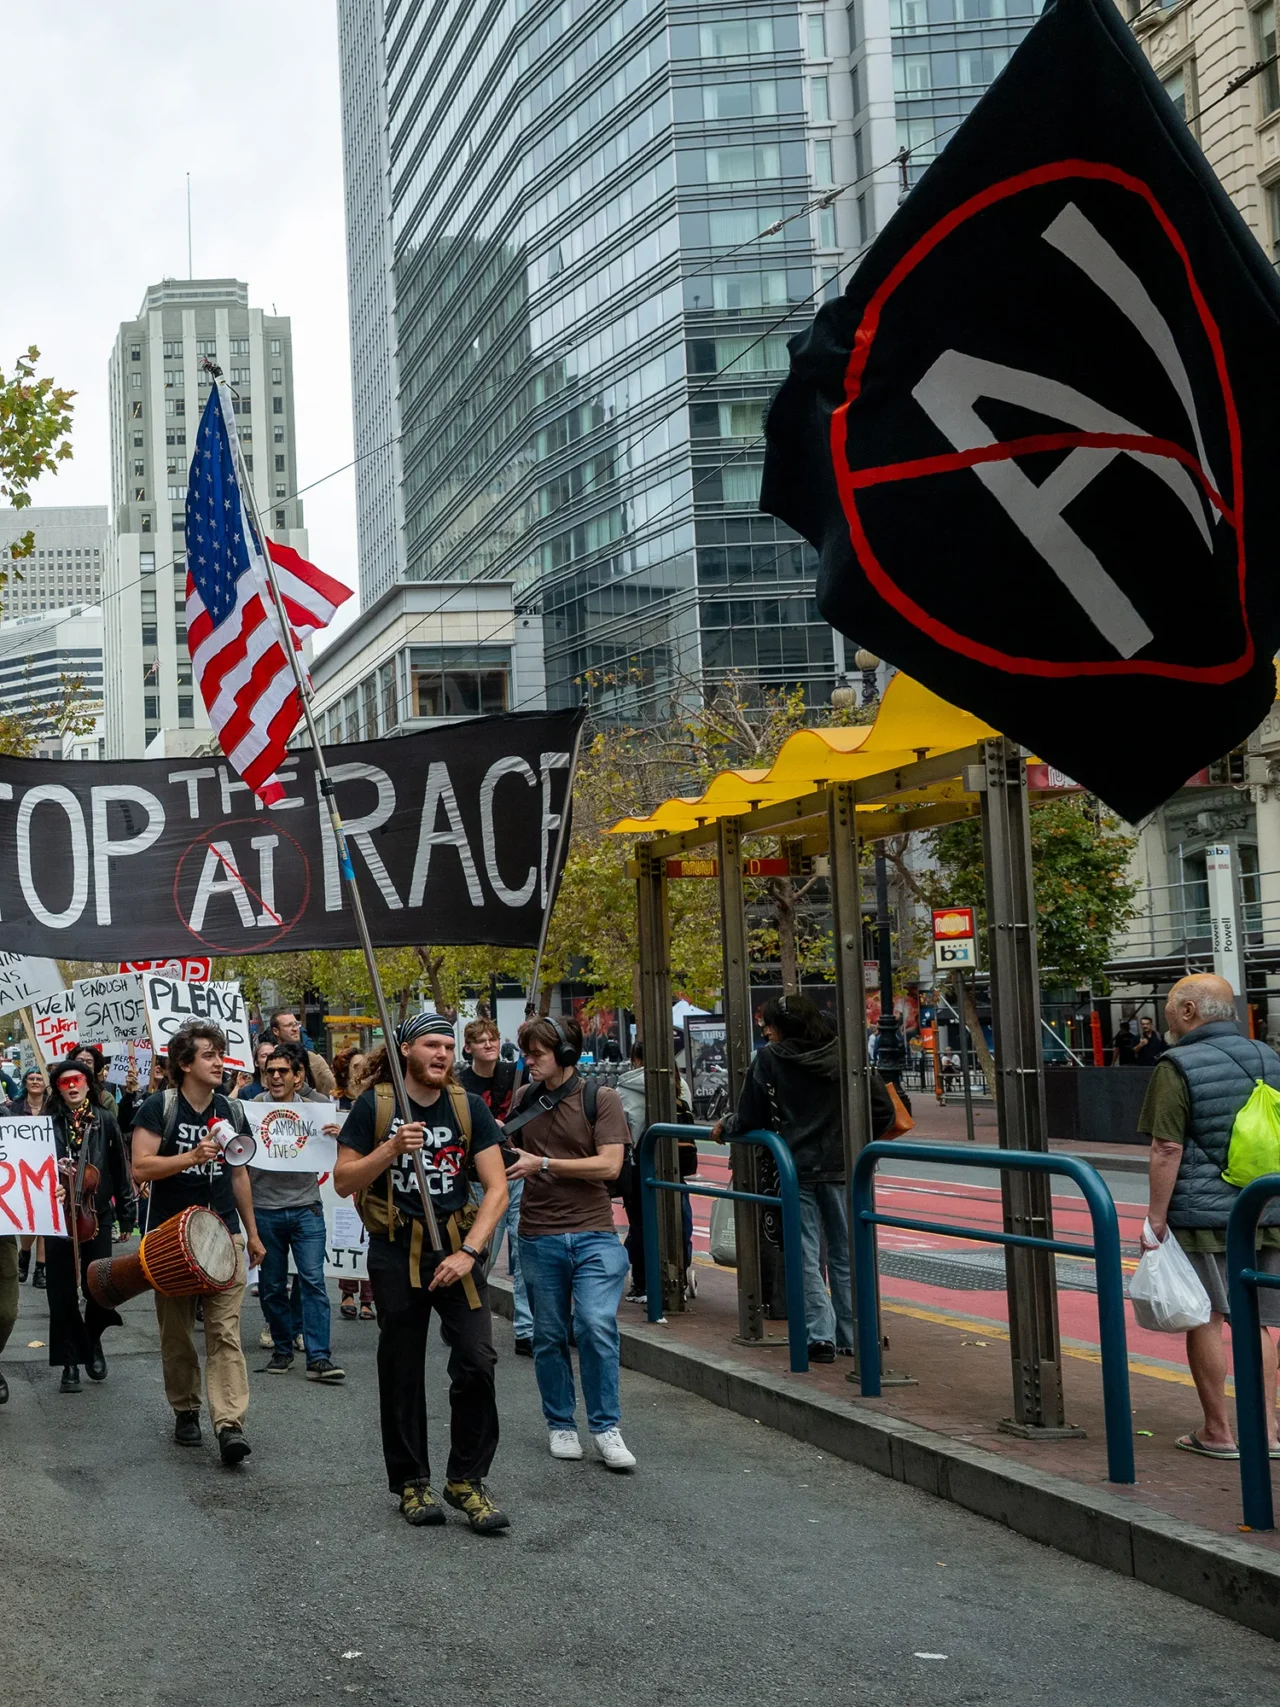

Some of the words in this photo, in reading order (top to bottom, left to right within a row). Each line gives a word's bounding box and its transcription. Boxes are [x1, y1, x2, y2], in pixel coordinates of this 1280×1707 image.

[168, 757, 305, 819] THE
[189, 834, 284, 932] AI
[1211, 918, 1220, 953] Powell
[1221, 917, 1233, 953] Powell
[80, 979, 128, 998] ENOUGH
[148, 977, 243, 1023] PLEASE
[35, 994, 63, 1016] We
[84, 999, 145, 1027] SATISF
[158, 1016, 245, 1056] SP
[138, 1067, 152, 1076] ATE
[178, 1122, 210, 1141] STO
[267, 1119, 318, 1137] GAMBLING
[267, 1143, 298, 1159] LIVES
[390, 1168, 454, 1195] RACE
